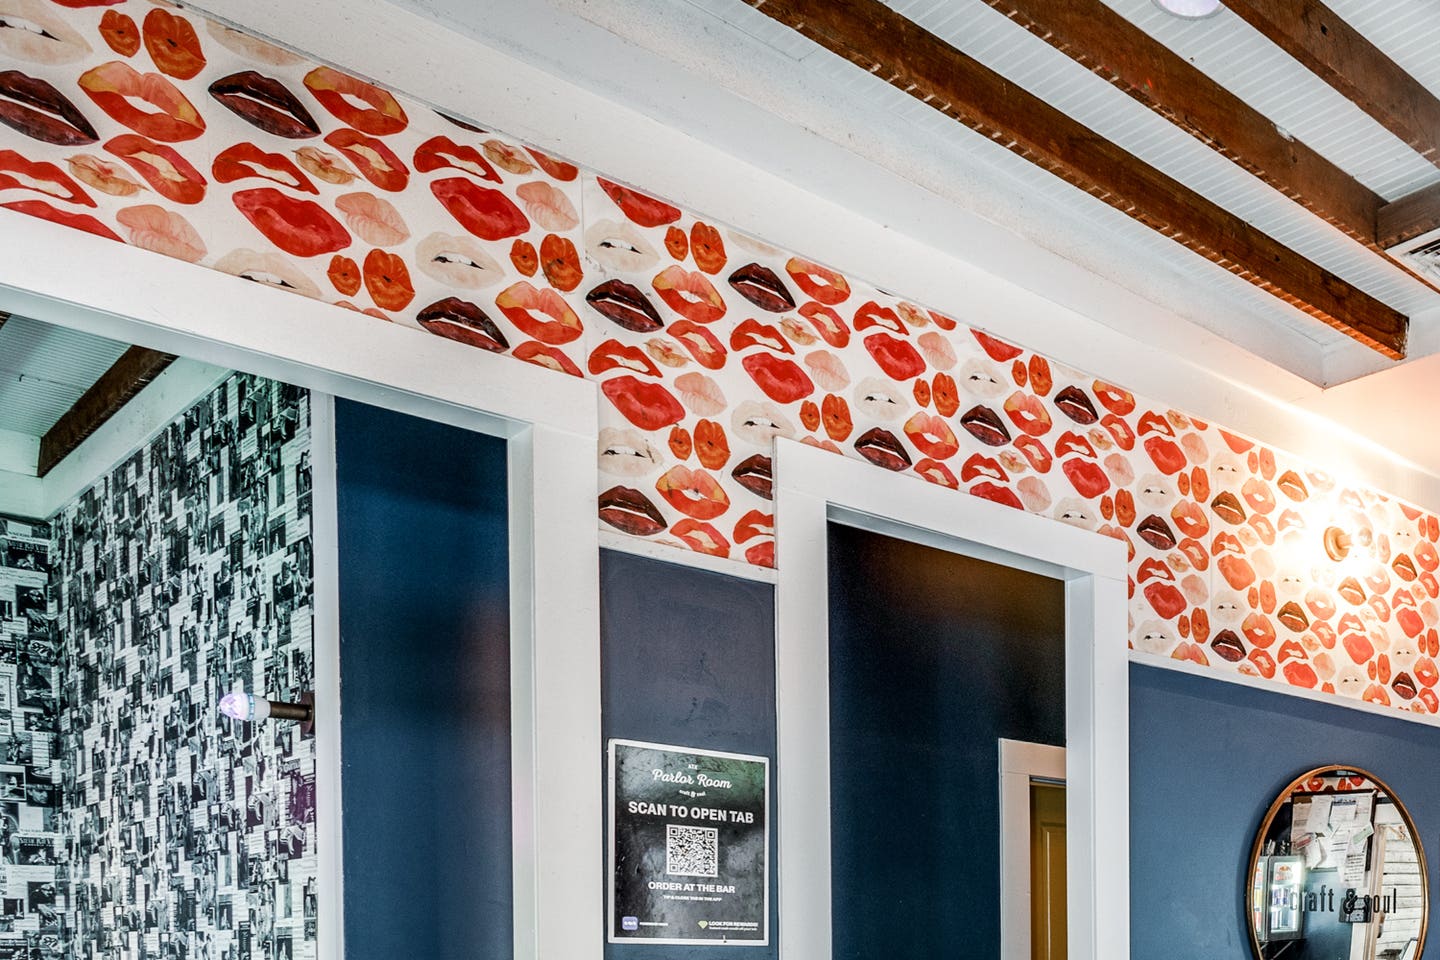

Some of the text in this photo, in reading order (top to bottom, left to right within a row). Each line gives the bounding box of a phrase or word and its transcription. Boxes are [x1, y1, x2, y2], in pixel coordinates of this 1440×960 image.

[652, 768, 732, 789] Parlor Room
[628, 801, 754, 824] SCAN TO OPEN TAB
[648, 882, 736, 894] ORDER AT THE BAR
[1290, 884, 1397, 914] craft & soul
